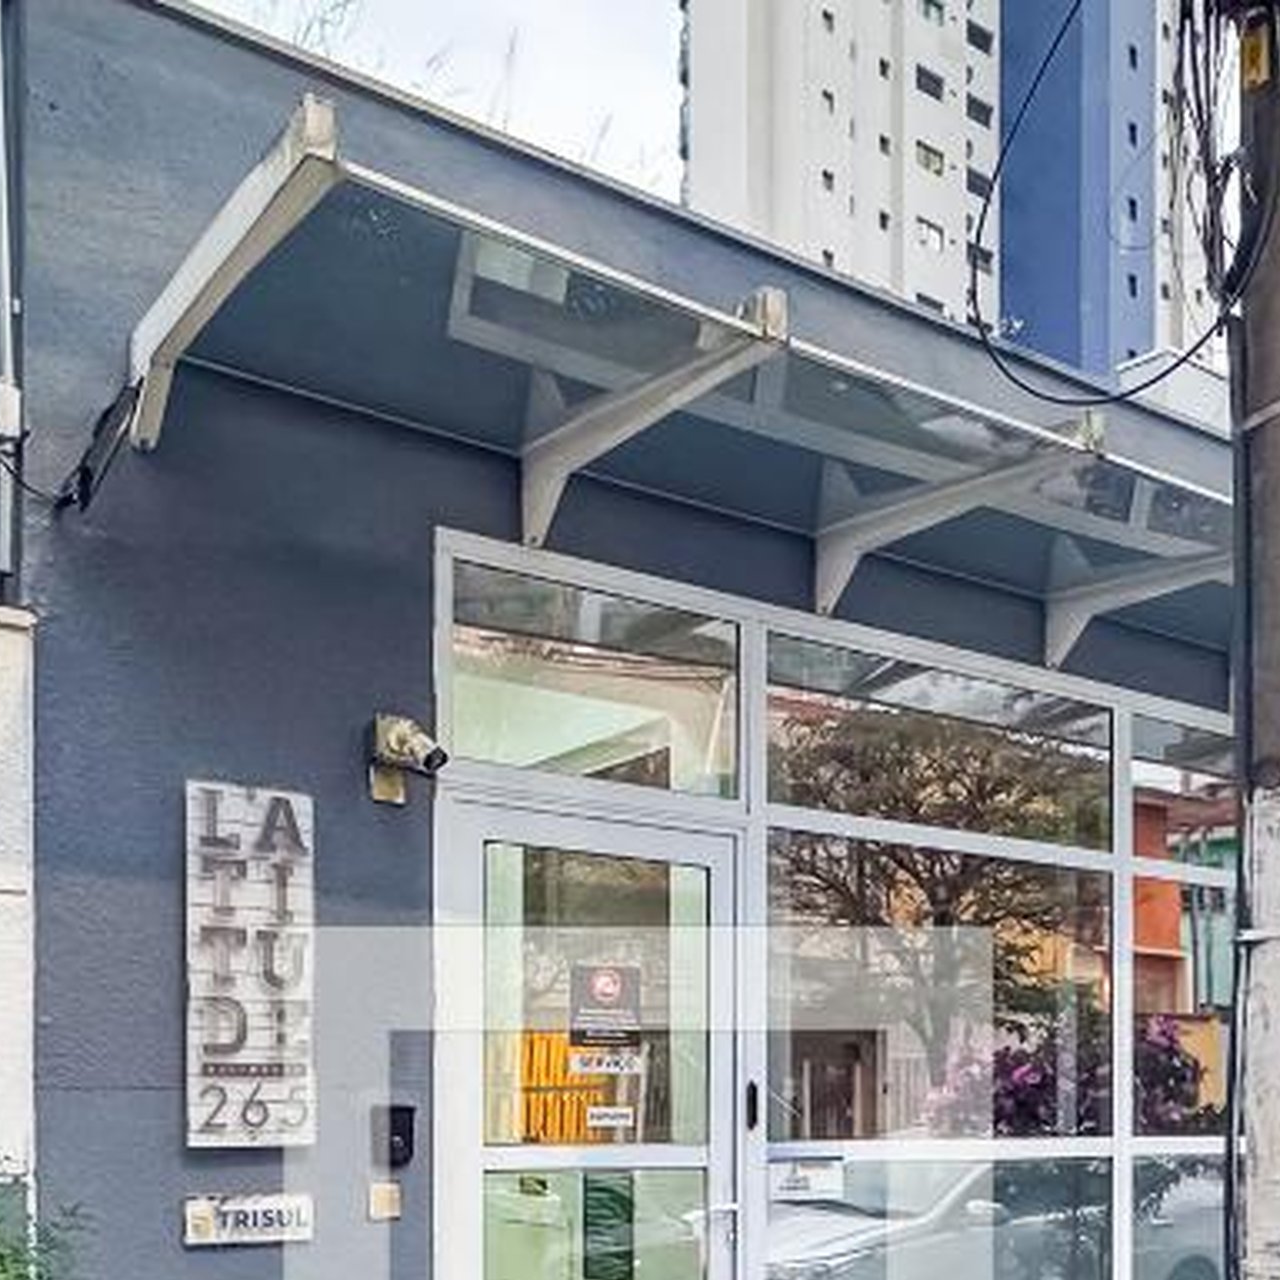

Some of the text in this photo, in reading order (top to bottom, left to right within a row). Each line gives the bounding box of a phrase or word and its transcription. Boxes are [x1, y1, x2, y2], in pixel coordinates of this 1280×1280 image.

[199, 786, 309, 857] LA
[200, 857, 294, 922] TI
[200, 926, 308, 993] TU
[200, 1081, 308, 1128] 265
[216, 1206, 310, 1229] TRISUL
